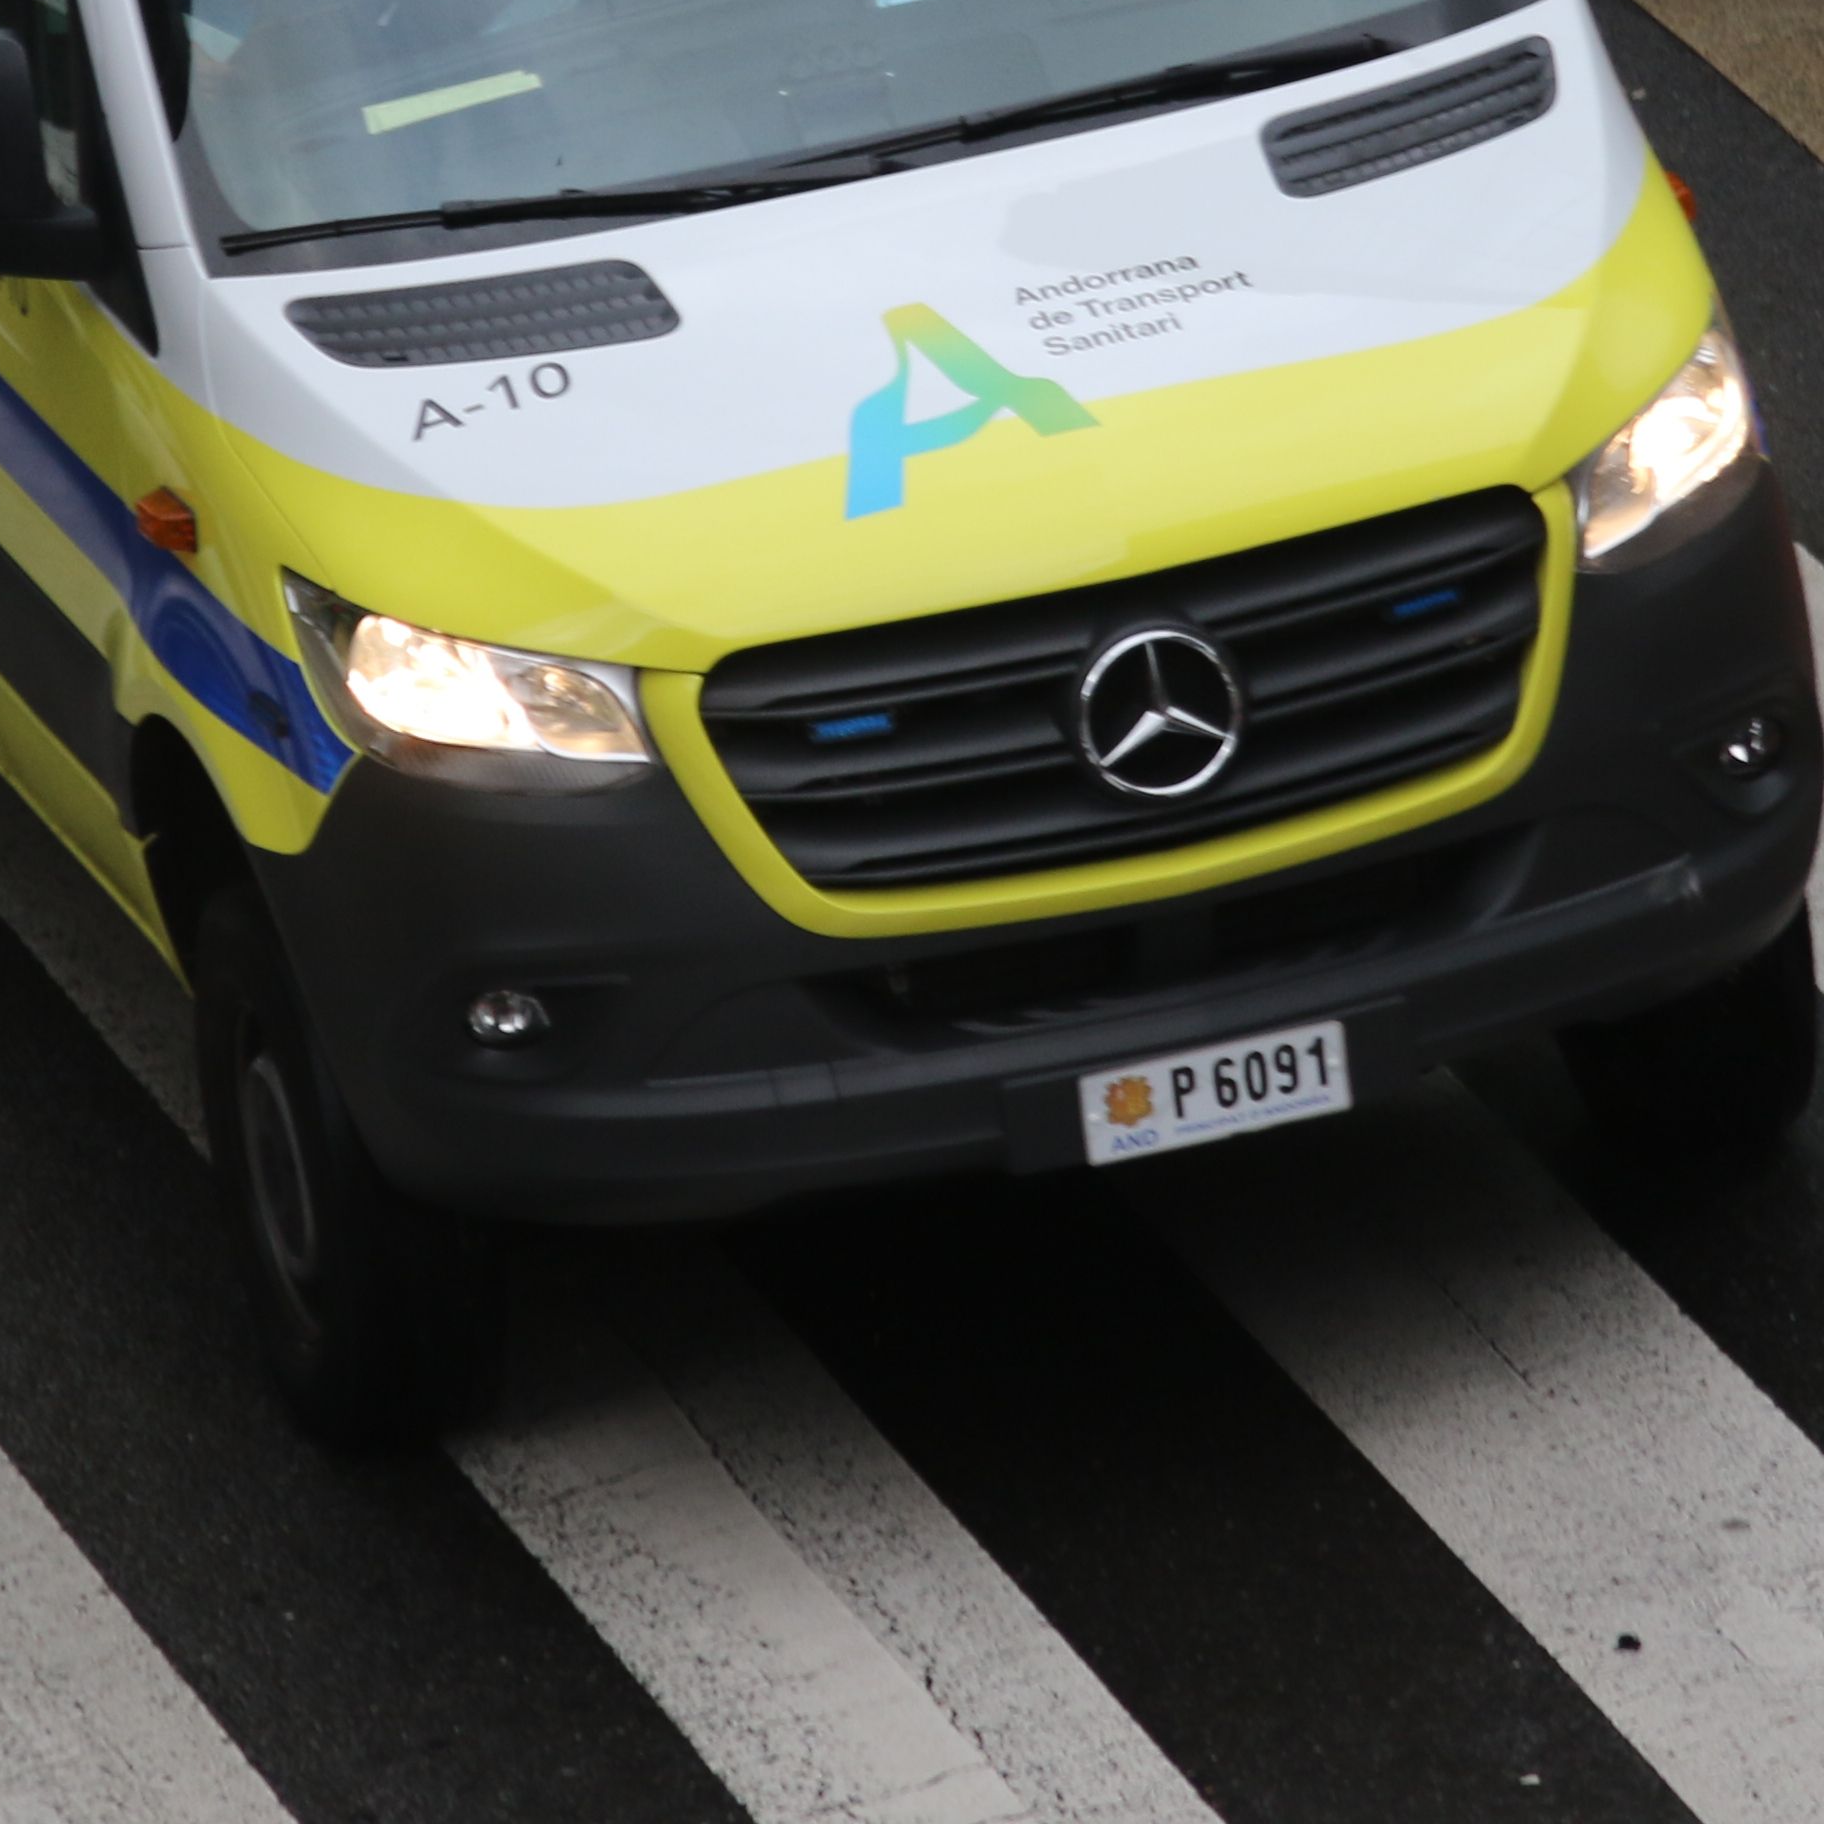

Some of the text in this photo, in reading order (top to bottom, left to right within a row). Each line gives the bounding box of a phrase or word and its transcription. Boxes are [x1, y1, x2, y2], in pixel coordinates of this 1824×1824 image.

[1015, 255, 1201, 306] Andorrana
[1029, 271, 1254, 332] de Transport
[1042, 312, 1184, 357] Sanitari
[412, 362, 571, 442] A-10
[1171, 1037, 1329, 1120] P 6091
[1111, 1129, 1160, 1155] AND
